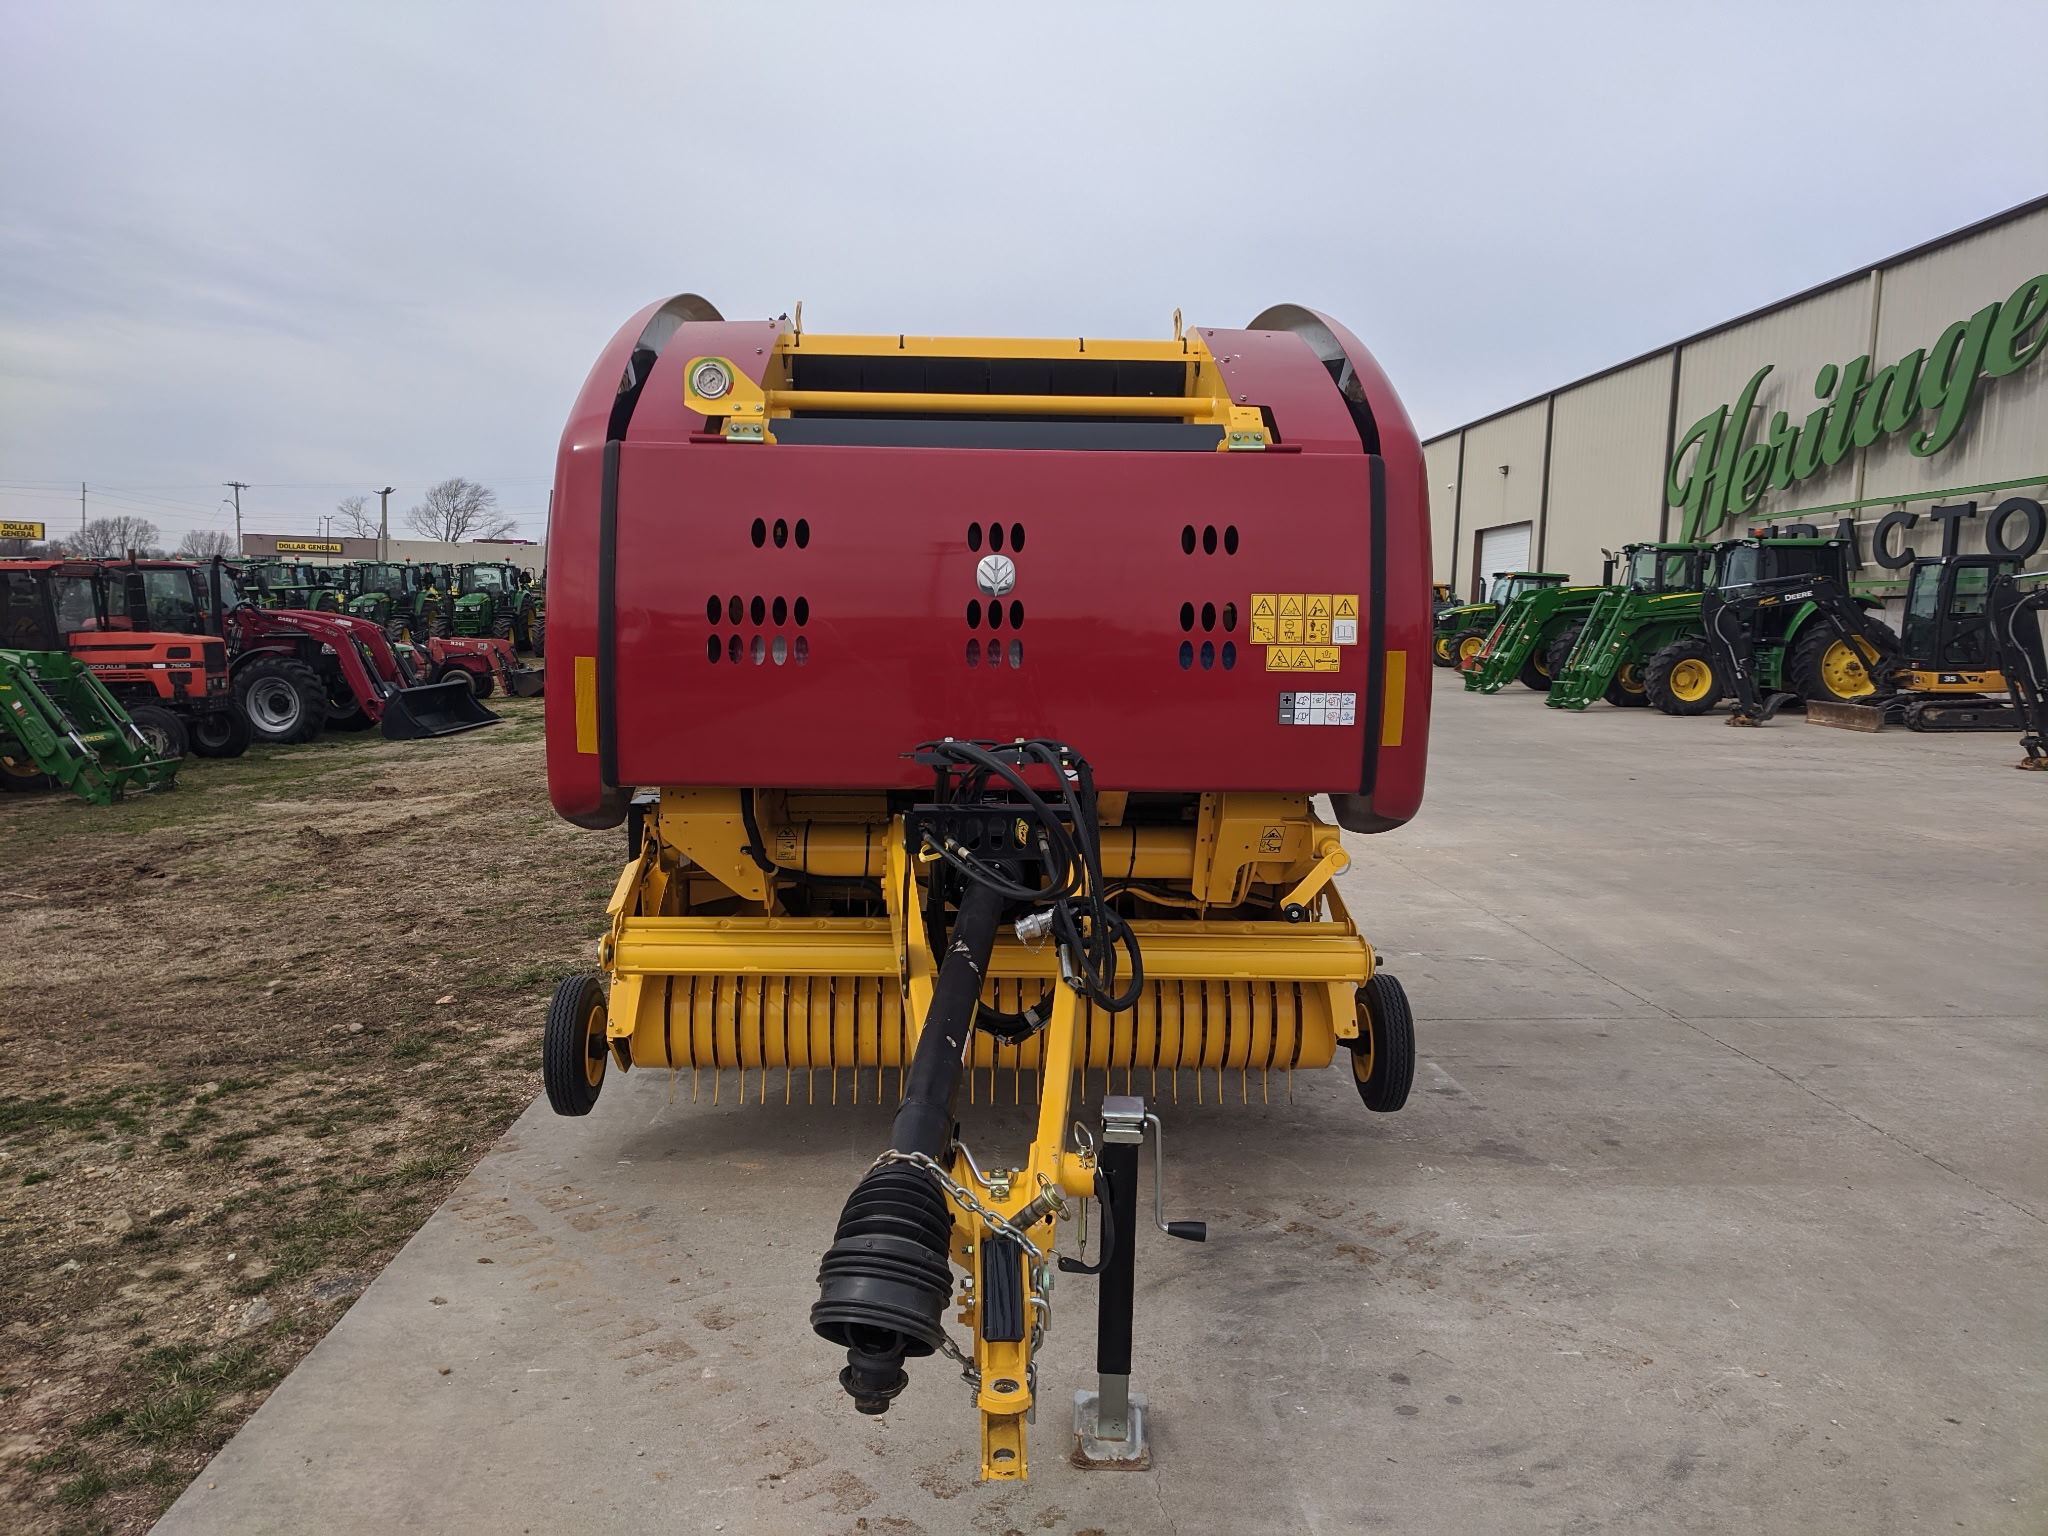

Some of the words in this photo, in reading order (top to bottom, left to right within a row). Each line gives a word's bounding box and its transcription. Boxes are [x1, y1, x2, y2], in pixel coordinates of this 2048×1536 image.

[1667, 274, 2048, 560] Heritage
[3, 523, 35, 531] DOLLAR
[1, 530, 37, 538] GENERAL
[278, 542, 306, 550] DOLLAR
[1784, 590, 1814, 602] DEERE
